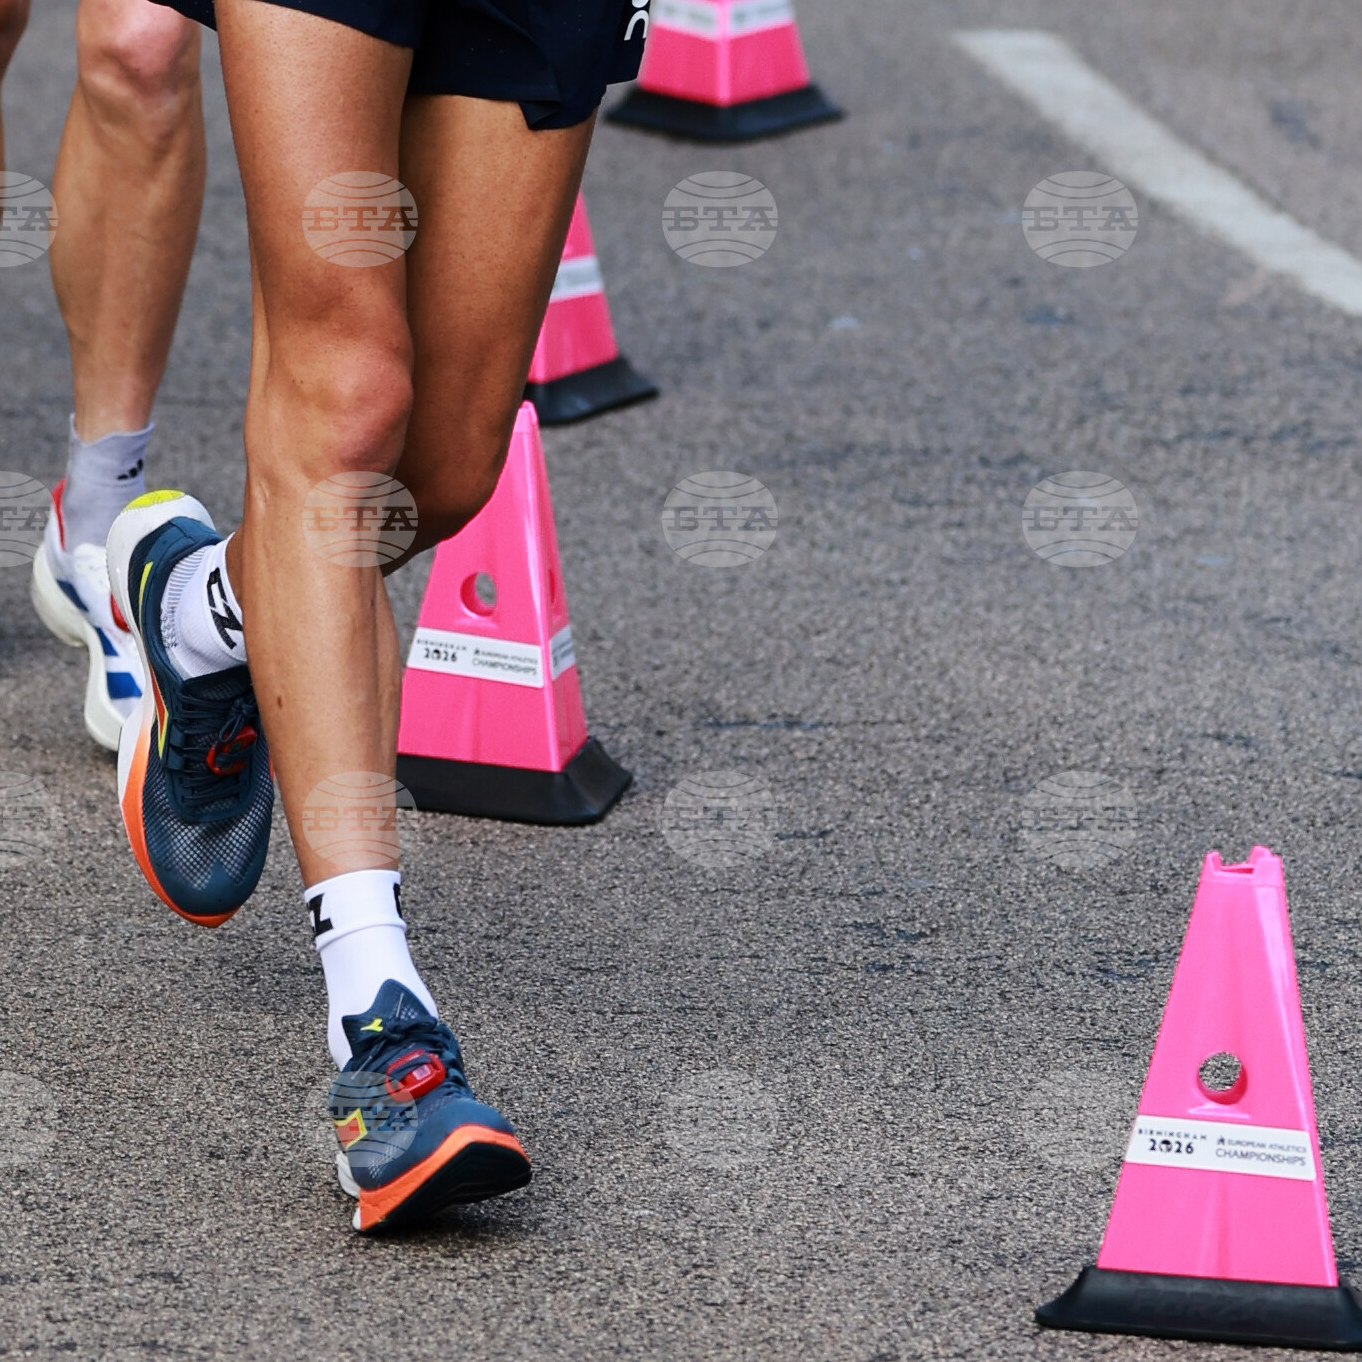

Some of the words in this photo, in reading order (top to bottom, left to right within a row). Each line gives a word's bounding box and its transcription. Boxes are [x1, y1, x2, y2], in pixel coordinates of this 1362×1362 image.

[472, 658, 537, 676] CHAMPIONSHIPS
[1138, 1128, 1208, 1140] BIRMINGHAM
[1148, 1138, 1194, 1155] 2026
[1228, 1138, 1266, 1149] EUROPEAN
[1268, 1141, 1307, 1154] ATHLETICS
[1215, 1147, 1306, 1167] CHAMPIONSHIPS
